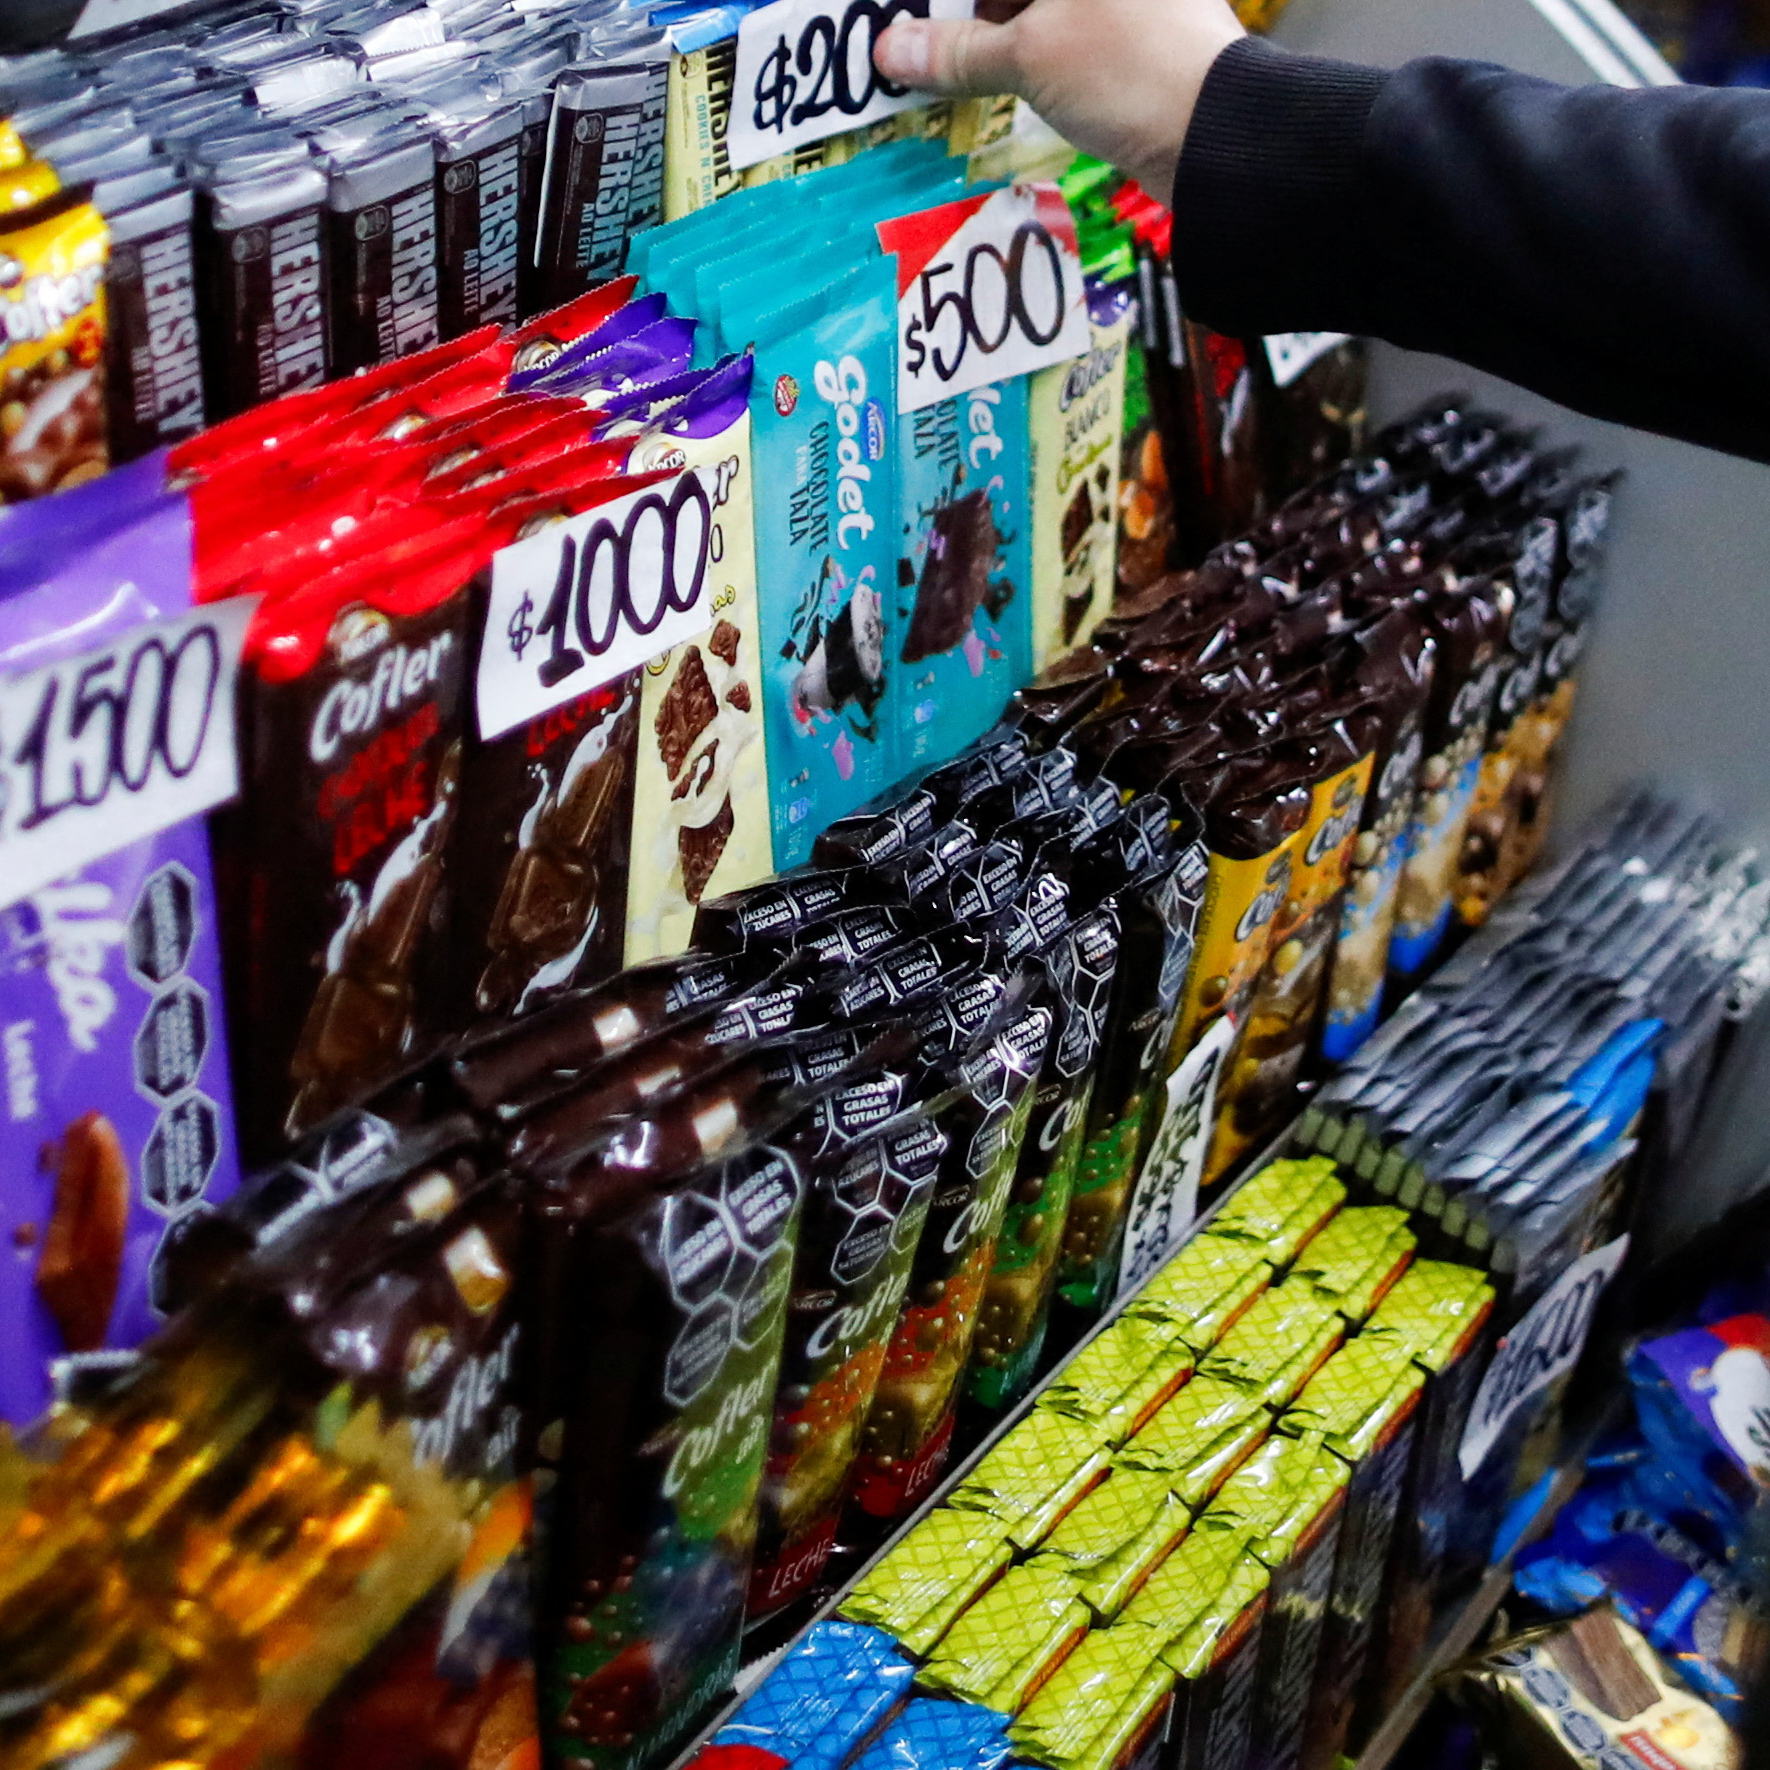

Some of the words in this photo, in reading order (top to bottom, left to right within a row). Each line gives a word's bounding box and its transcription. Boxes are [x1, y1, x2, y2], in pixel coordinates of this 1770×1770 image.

[905, 218, 1066, 382] $500
[864, 401, 879, 462] ARCOR
[807, 420, 832, 558] CHOCOLATE
[788, 483, 811, 547] TAZA
[508, 469, 712, 688] $1000
[310, 628, 453, 763] Cofler
[991, 868, 1018, 892] GRASAS
[775, 899, 788, 912] EN
[1036, 902, 1065, 925] GRASAS
[856, 929, 896, 951] TOTALES
[1084, 939, 1118, 964] TOTALES
[899, 966, 939, 991] TOTALES
[958, 988, 997, 1013] GRASAS
[1010, 1028, 1046, 1050] GRASAS
[843, 1094, 890, 1112] GRASAS
[842, 1106, 892, 1127] TOTALES
[894, 1129, 934, 1152] GRASAS
[894, 1141, 942, 1167] TOTALES
[410, 1322, 520, 1470] ofler
[661, 1356, 777, 1498] Cofler
[767, 1535, 832, 1600] LECHE
